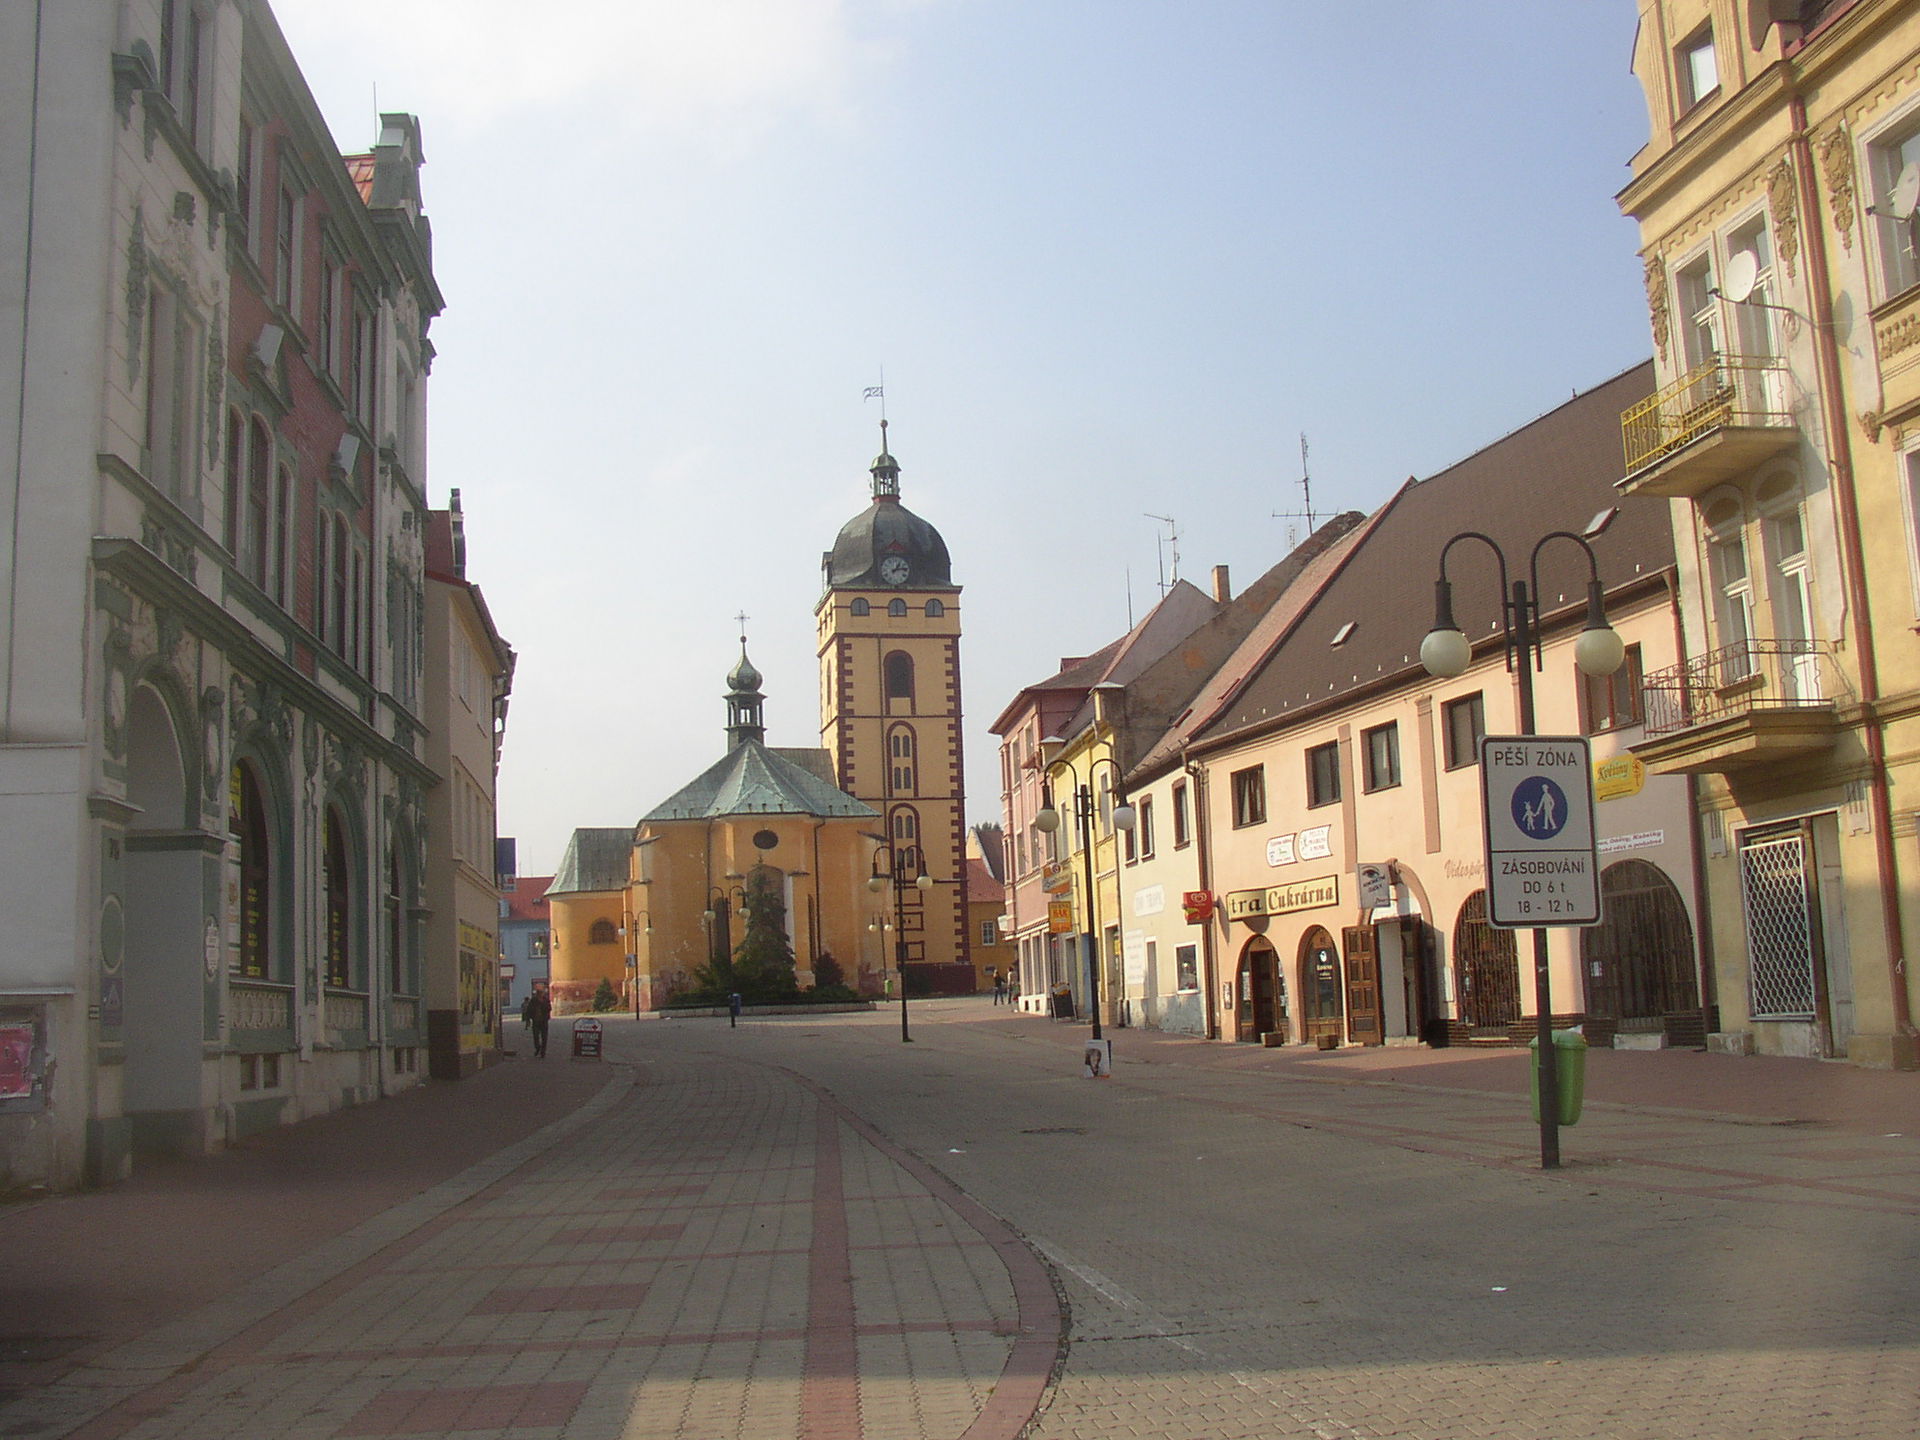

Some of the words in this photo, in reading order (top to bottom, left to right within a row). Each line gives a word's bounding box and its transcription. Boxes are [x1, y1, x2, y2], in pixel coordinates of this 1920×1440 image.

[1494, 746, 1529, 766] PĚŠÍ
[1536, 747, 1578, 766] ZÓNA
[1502, 857, 1585, 875] ZÁSOBOVÁNÍ
[1523, 881, 1541, 894] DO
[1547, 881, 1555, 894] 6
[1560, 882, 1566, 893] t
[1268, 886, 1334, 910] Cukrárna
[1518, 900, 1531, 913] 18
[1549, 900, 1561, 913] 12
[1566, 900, 1574, 912] h
